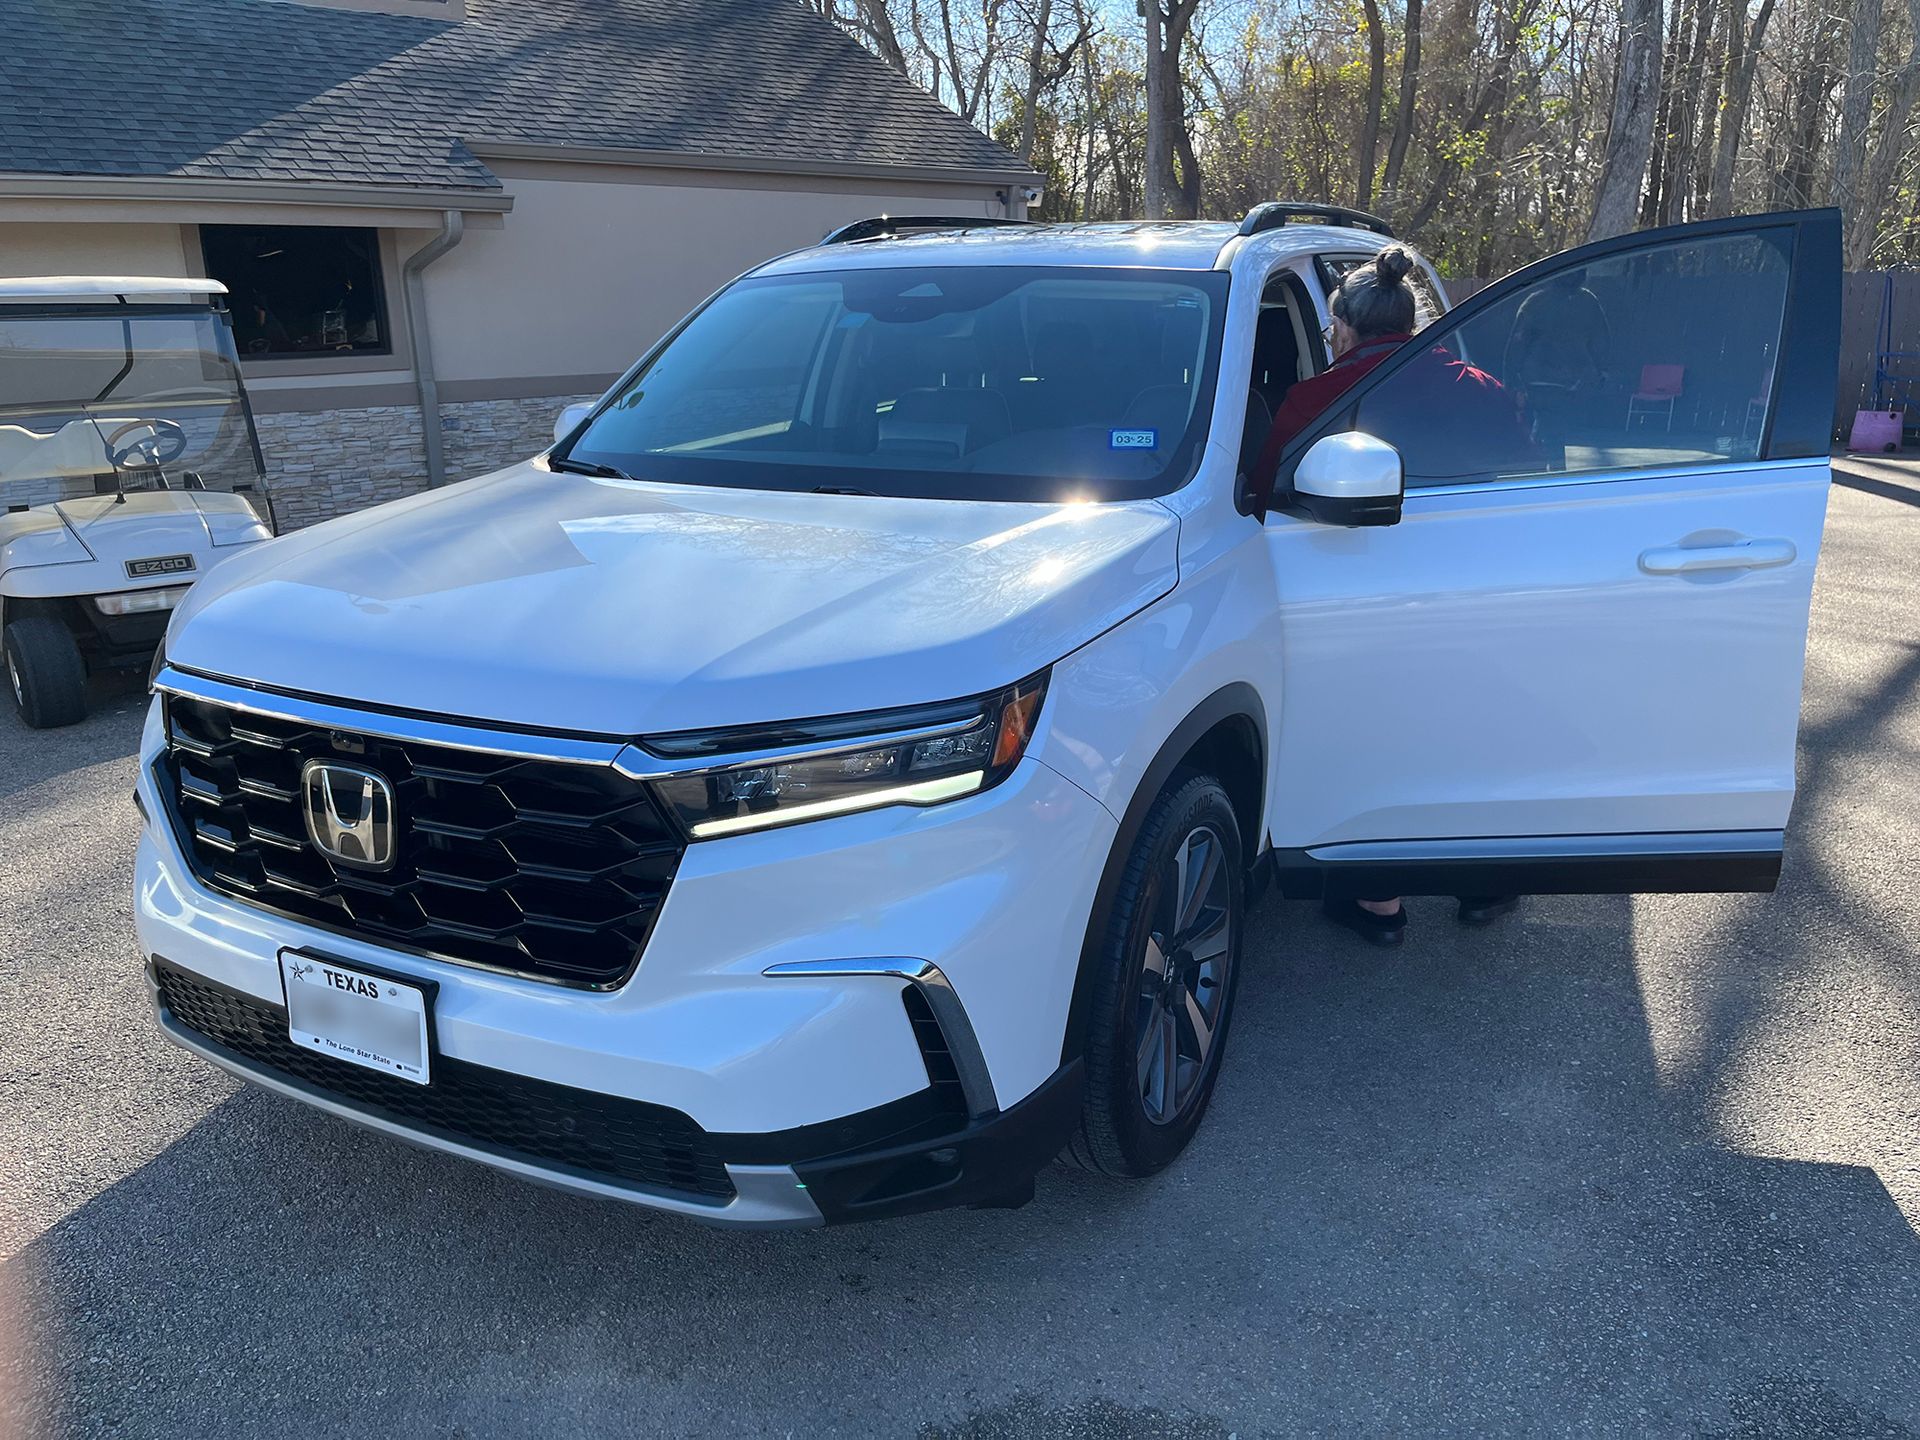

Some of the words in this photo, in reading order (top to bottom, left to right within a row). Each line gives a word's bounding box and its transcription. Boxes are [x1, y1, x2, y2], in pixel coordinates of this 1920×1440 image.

[1137, 435, 1151, 443] 25
[323, 969, 378, 999] TEXAS
[325, 1039, 337, 1049] The
[339, 1044, 355, 1053] Lone
[357, 1049, 371, 1059] Star
[373, 1054, 390, 1065] State
